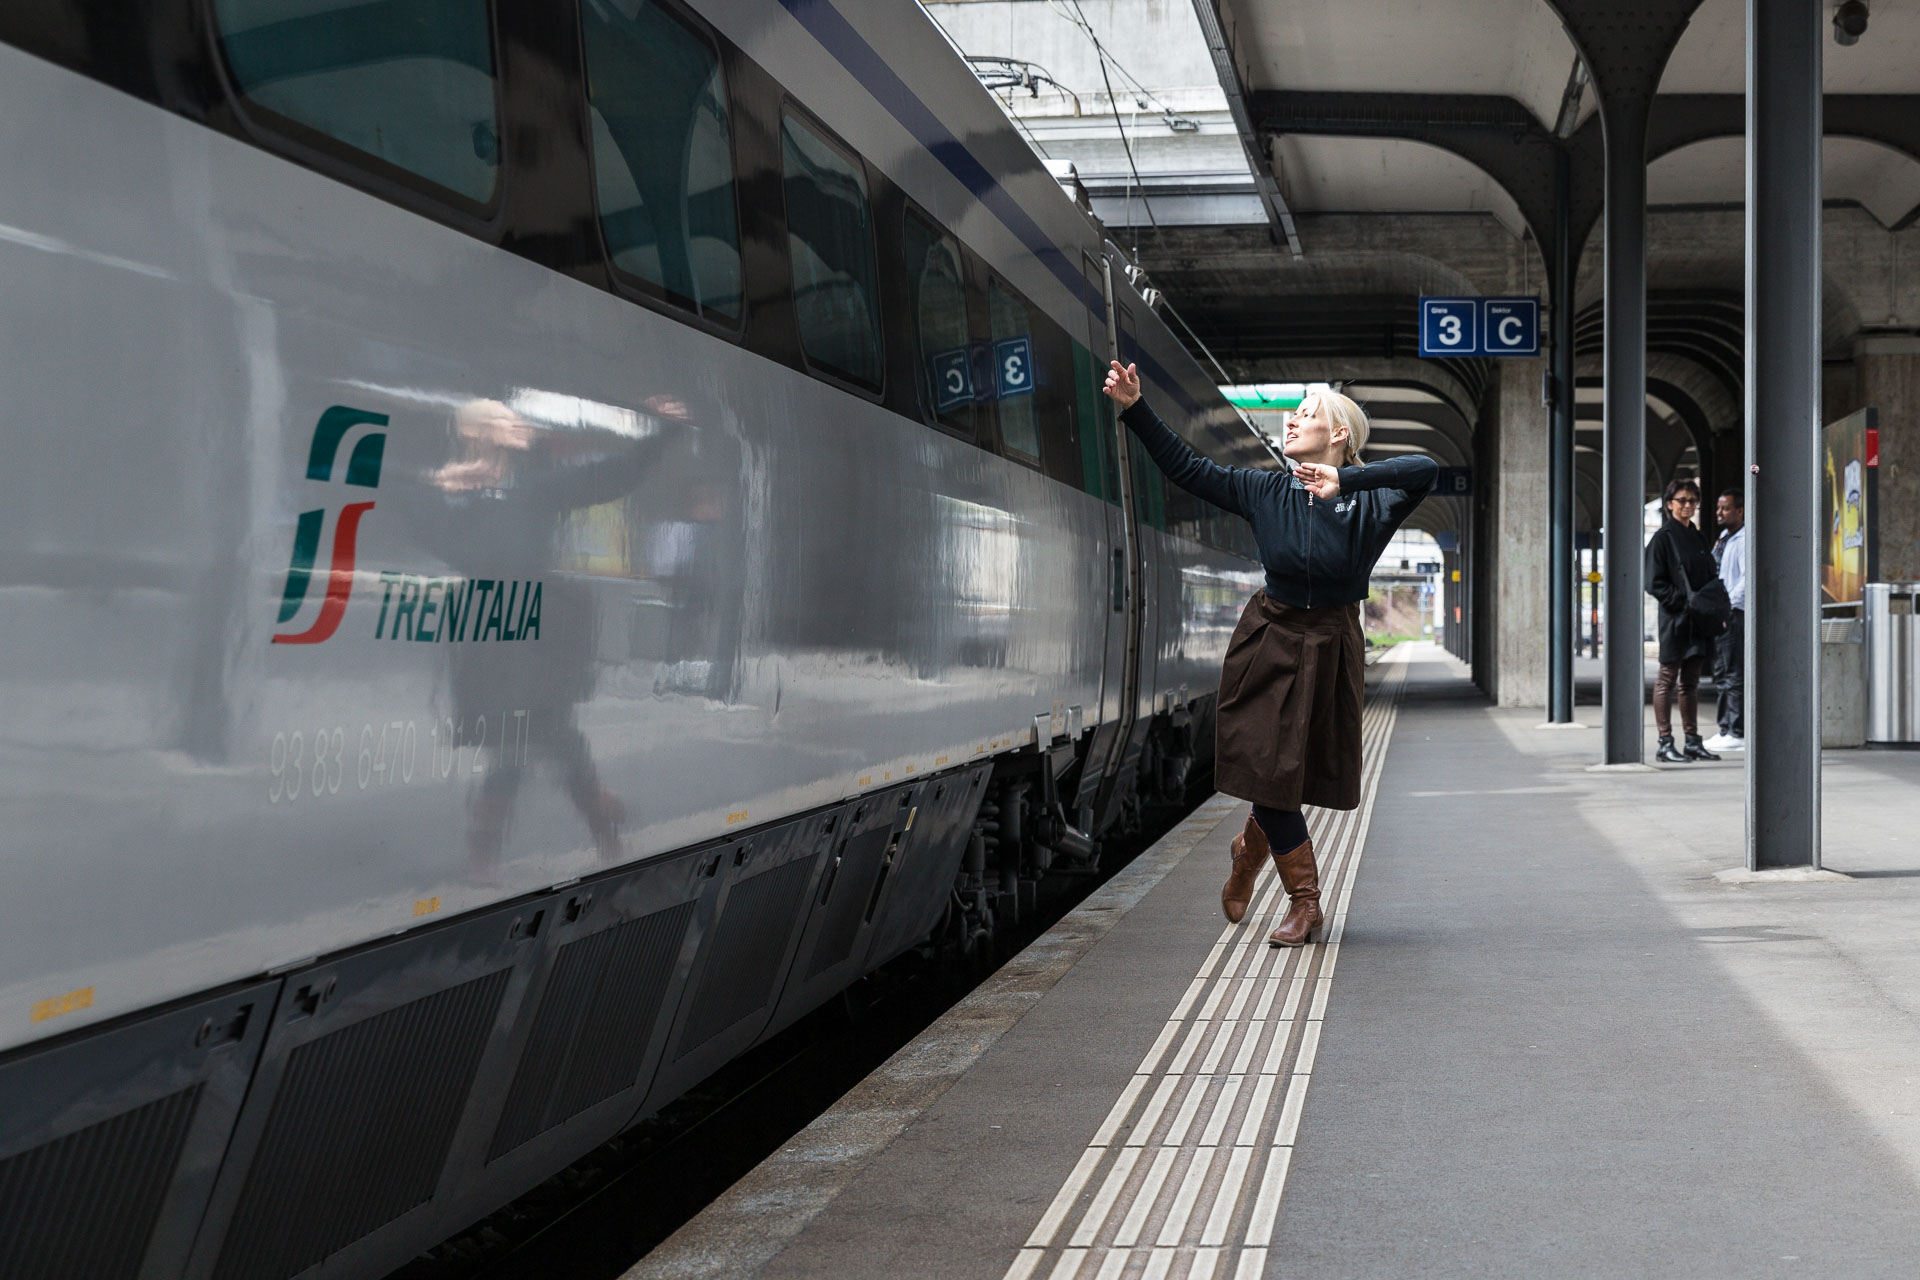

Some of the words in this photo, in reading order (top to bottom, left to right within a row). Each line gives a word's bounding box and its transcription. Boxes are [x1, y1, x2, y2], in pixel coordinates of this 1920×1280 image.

[1438, 315, 1462, 346] 3
[1498, 316, 1523, 346] C
[1455, 476, 1467, 491] B
[375, 571, 543, 642] TRENITALIA
[269, 730, 304, 804] 93
[311, 726, 345, 798] 83
[357, 720, 416, 790] 6470
